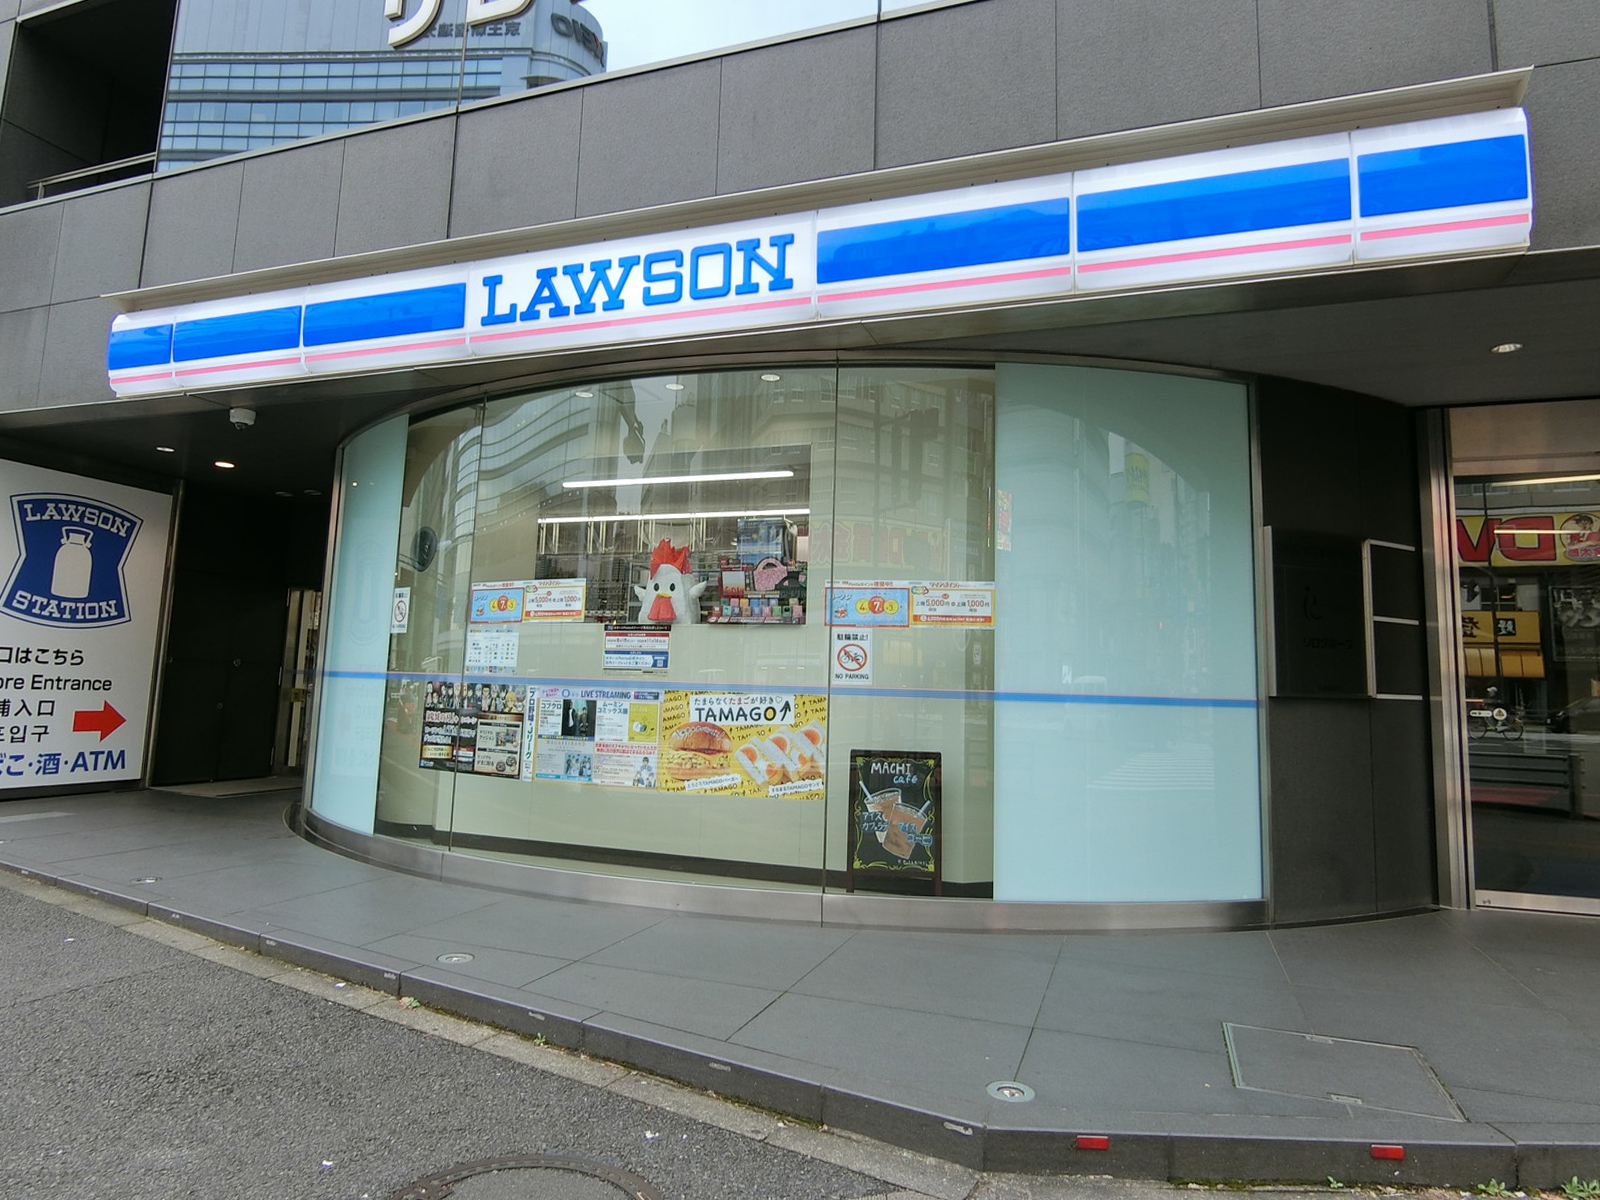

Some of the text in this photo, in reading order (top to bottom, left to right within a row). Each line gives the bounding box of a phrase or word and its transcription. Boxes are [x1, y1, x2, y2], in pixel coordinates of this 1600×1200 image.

[481, 233, 795, 327] LAWSON
[23, 502, 131, 538] LAWSON
[12, 590, 118, 620] STATION
[0, 674, 112, 691] re Entrance
[581, 690, 594, 698] LIVE
[595, 690, 631, 699] STREAMING
[695, 706, 776, 722] TAMAGO
[871, 763, 911, 775] MACHI
[862, 811, 884, 820] アイス
[898, 823, 917, 831] アイス
